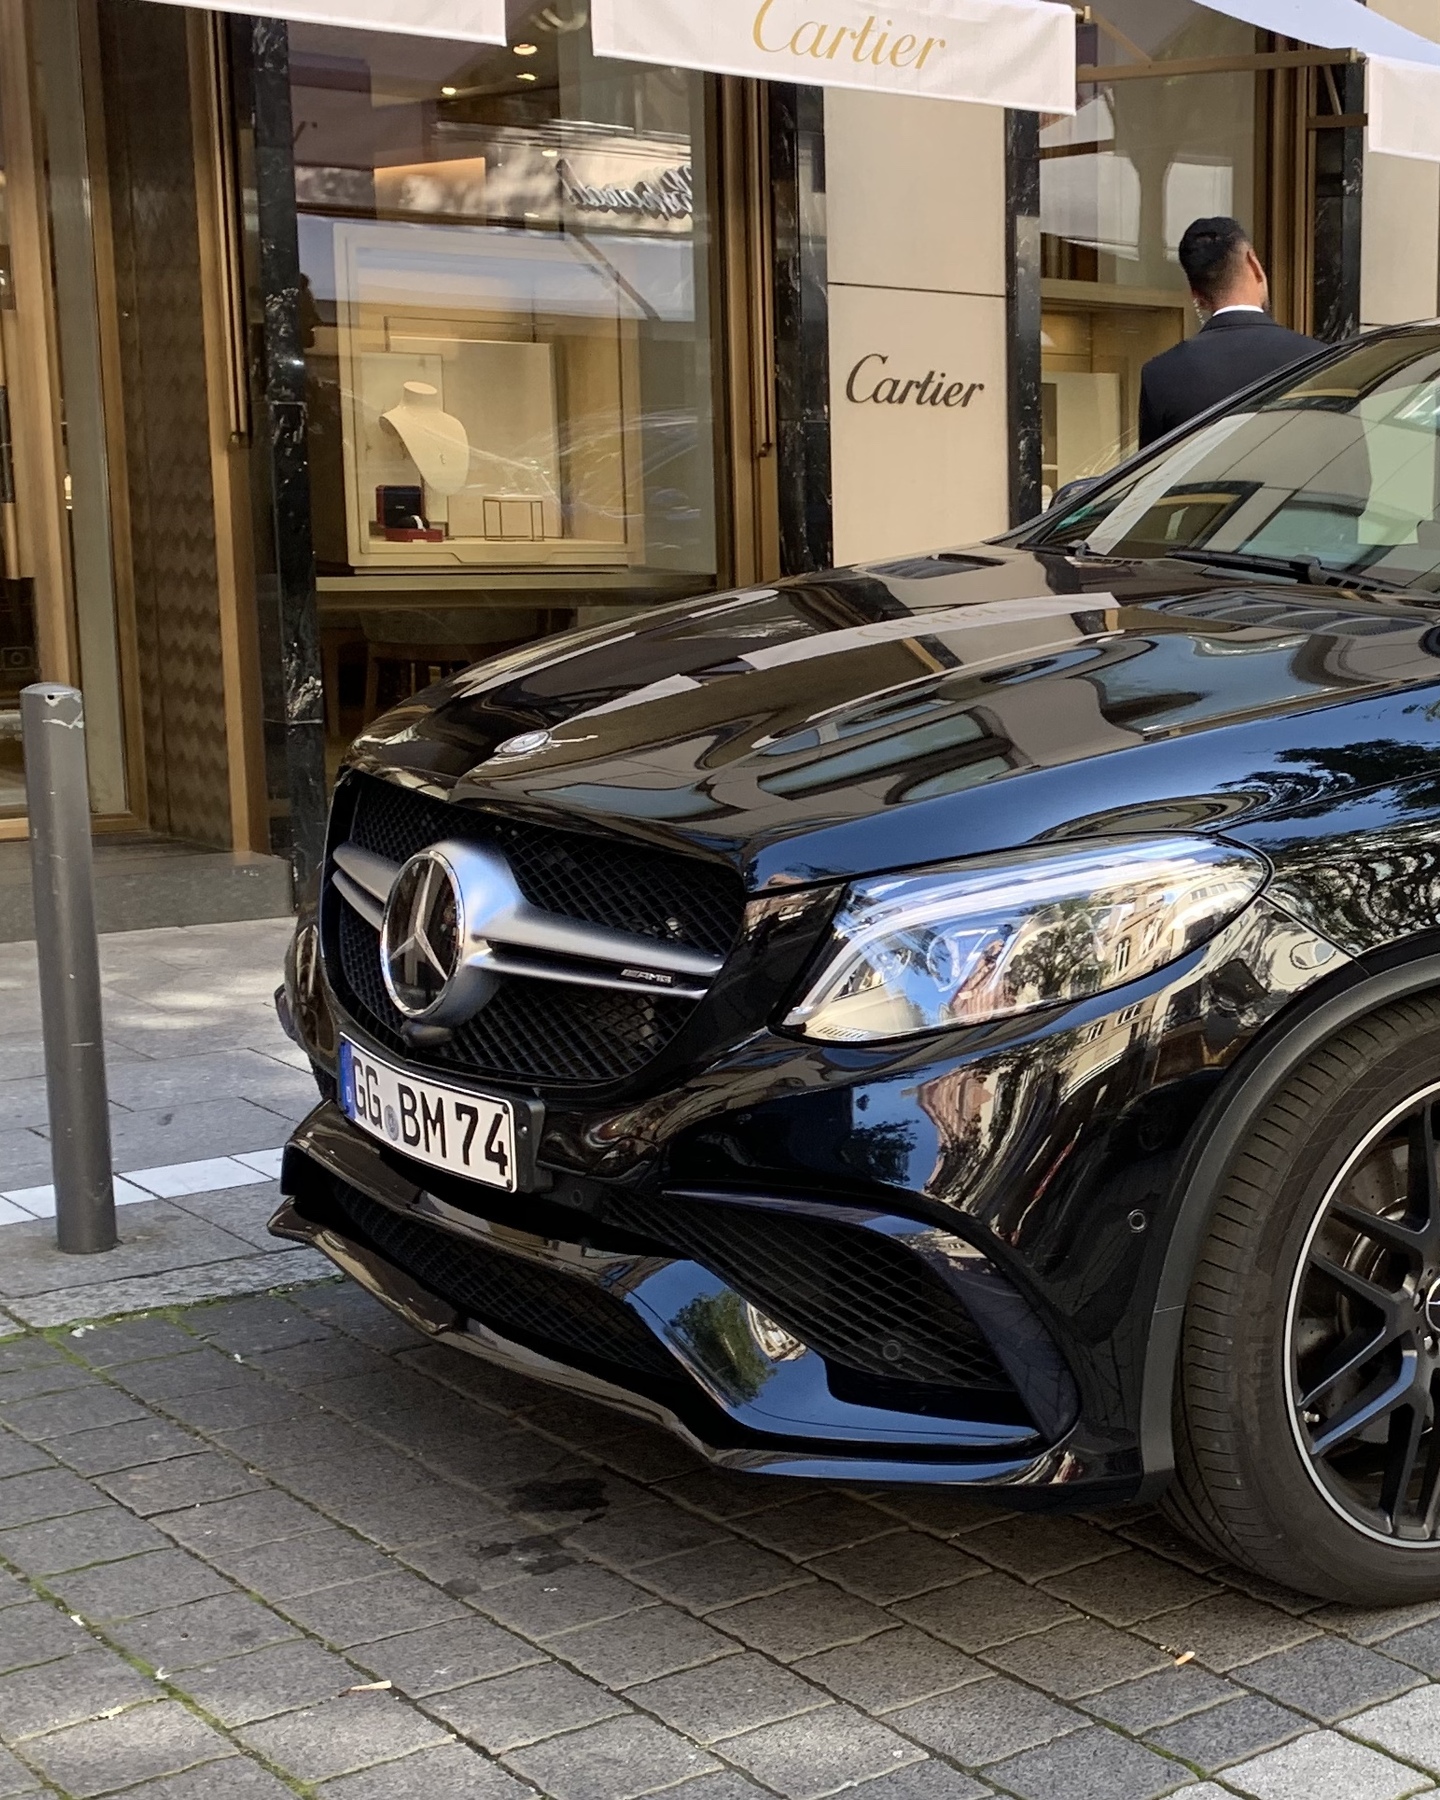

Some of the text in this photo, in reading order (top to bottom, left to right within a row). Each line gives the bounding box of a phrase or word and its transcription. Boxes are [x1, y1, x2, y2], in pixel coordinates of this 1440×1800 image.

[752, 0, 946, 70] Cartier
[846, 353, 985, 407] Cartier
[353, 1056, 508, 1176] GG BM 74
